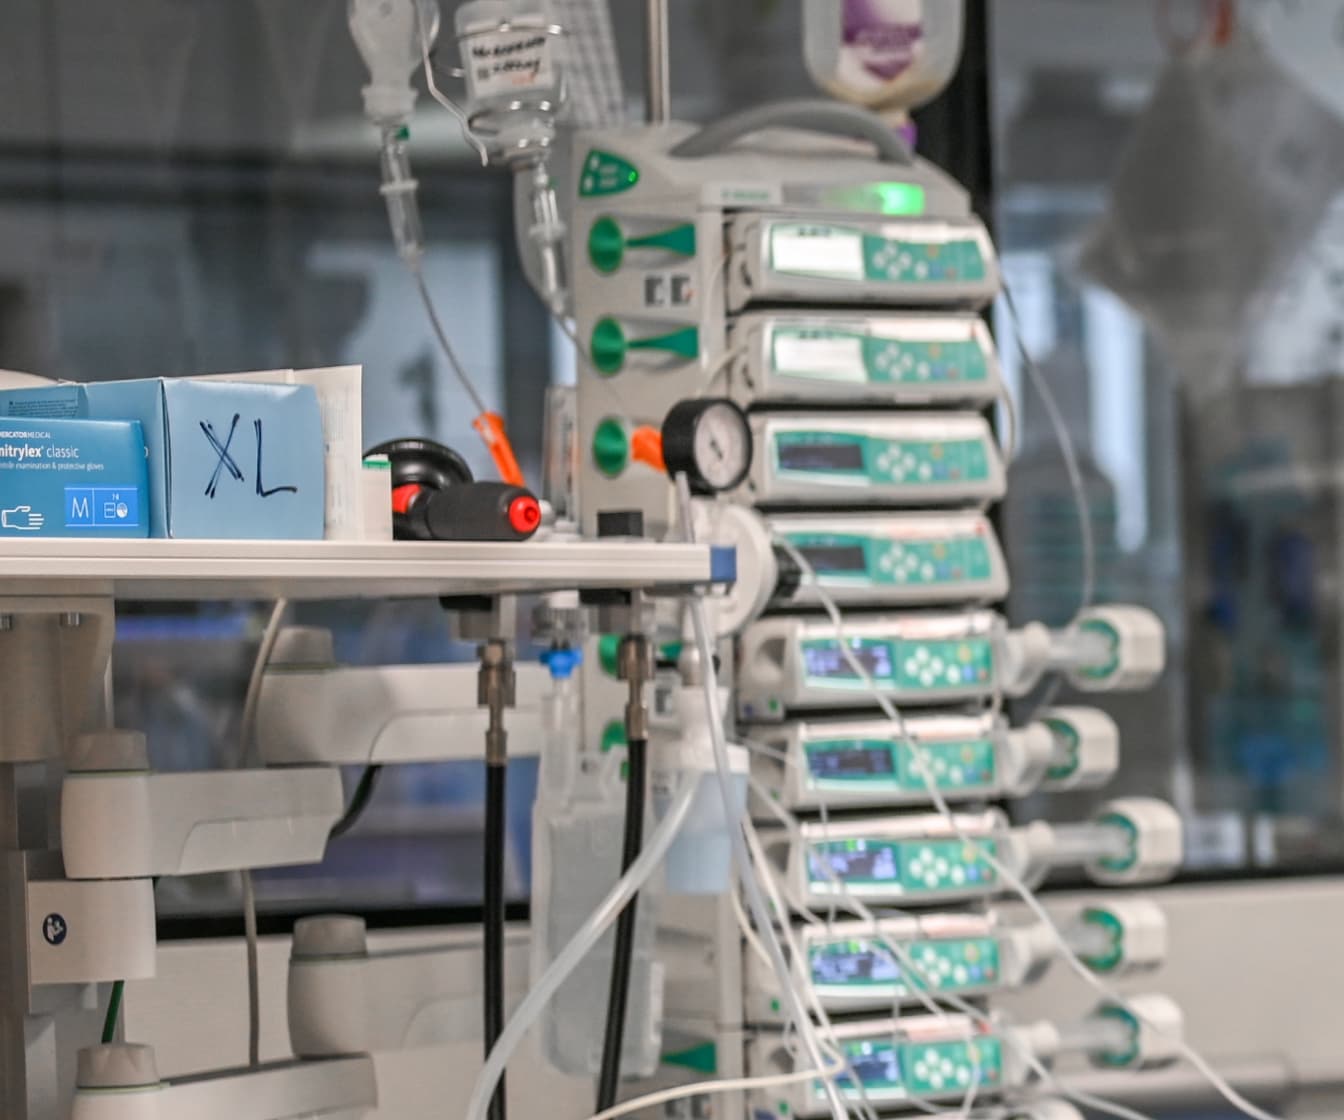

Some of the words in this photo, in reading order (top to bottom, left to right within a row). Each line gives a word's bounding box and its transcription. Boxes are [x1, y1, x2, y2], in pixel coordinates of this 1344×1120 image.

[46, 444, 79, 459] classic
[199, 413, 298, 499] XL
[86, 461, 105, 472] gloves
[71, 496, 89, 519] M
